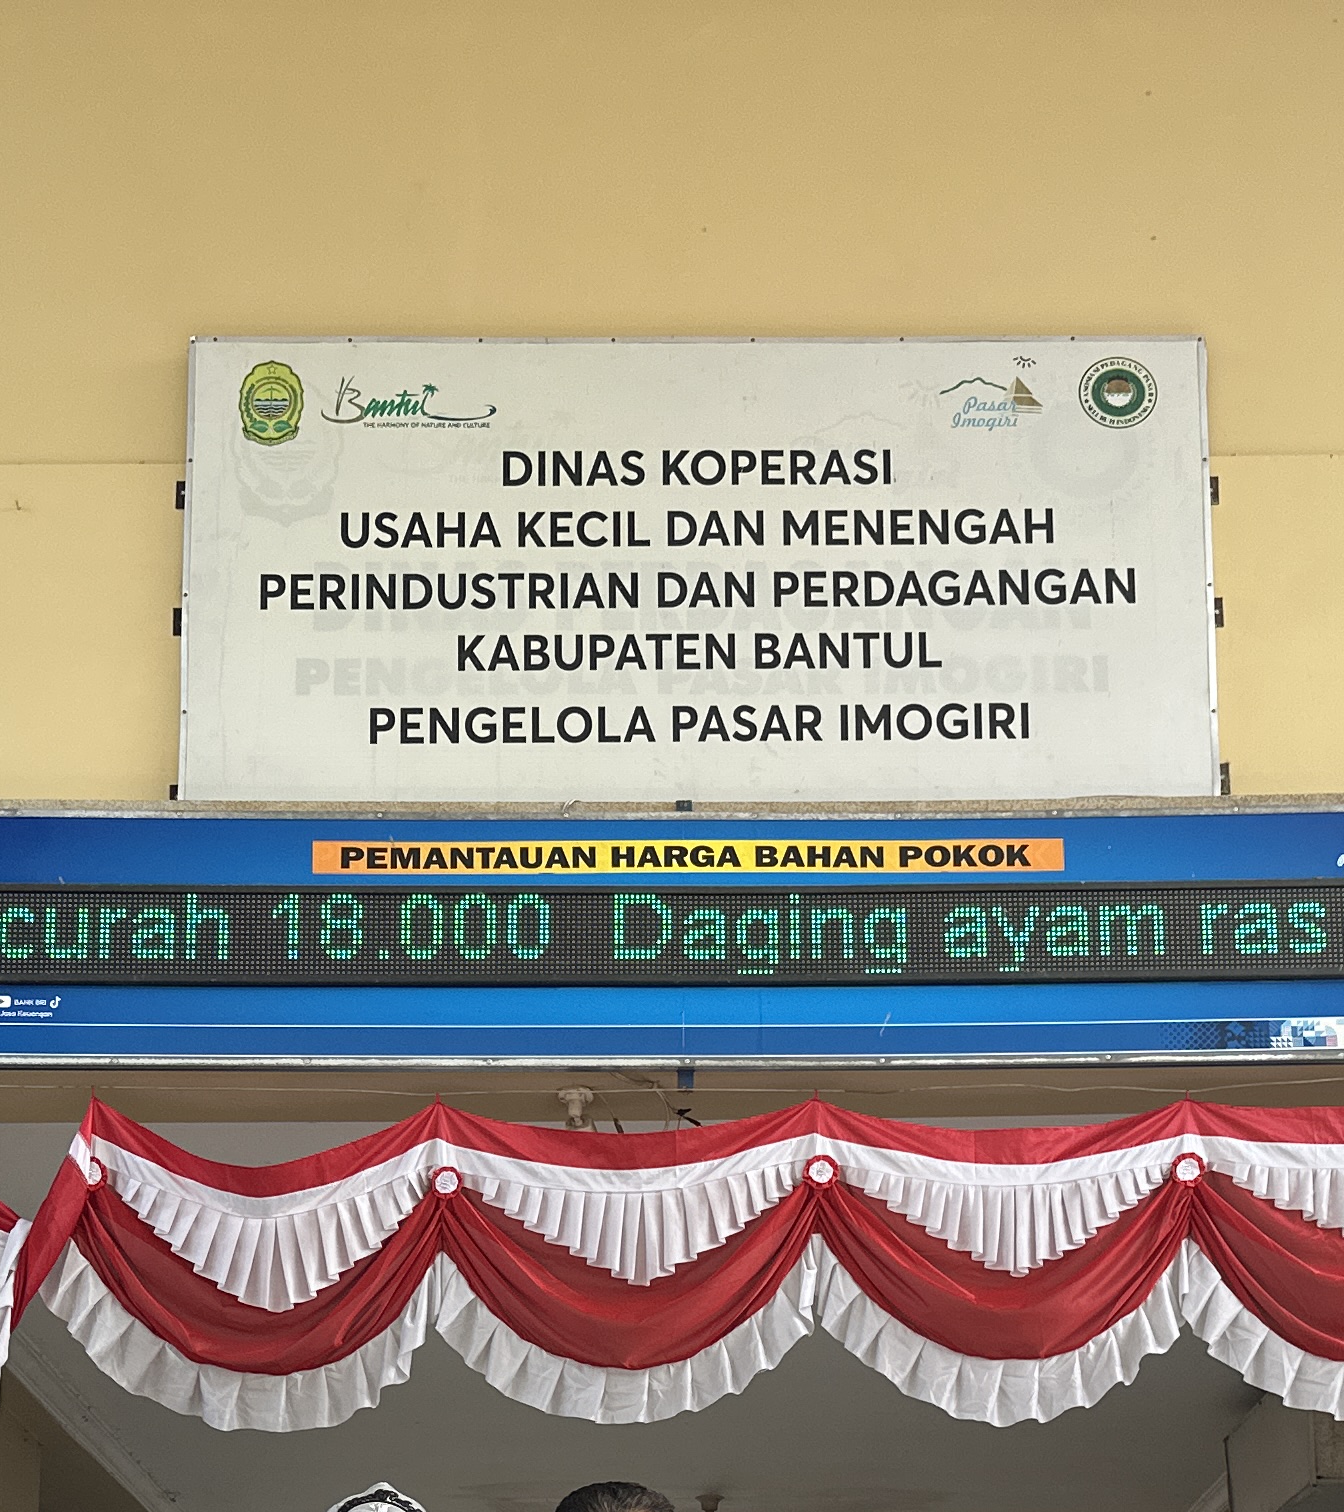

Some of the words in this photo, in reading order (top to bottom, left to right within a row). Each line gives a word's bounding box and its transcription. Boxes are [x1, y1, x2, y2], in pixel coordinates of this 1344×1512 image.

[321, 375, 441, 424] Bantul
[962, 396, 1016, 413] Pasar
[950, 412, 1019, 431] Imogiri
[503, 451, 645, 486] DINAS
[663, 450, 890, 485] KOPERASI
[341, 512, 501, 548] USAHA
[518, 511, 650, 547] KECIL
[668, 511, 764, 546] DAN
[783, 508, 1053, 545] MENENGAH
[261, 573, 638, 610] PERINDUSTRIAN
[658, 572, 754, 608] DAN
[774, 568, 1135, 607] PERDAGANGAN
[458, 634, 735, 671] KABUPATEN
[755, 632, 942, 669] BANTUL
[370, 706, 655, 744] PENGELOLA
[673, 705, 822, 742] PASAR
[841, 703, 1029, 740] IMOGIRI
[341, 847, 595, 869] PEMANTAUAN
[612, 846, 741, 867] HARGA
[756, 846, 883, 867] BAHAN
[900, 845, 1031, 867] POKOK
[273, 894, 549, 959] 18.000
[614, 894, 906, 974] Daging
[944, 905, 1165, 972] ayam
[1200, 901, 1327, 954] ras
